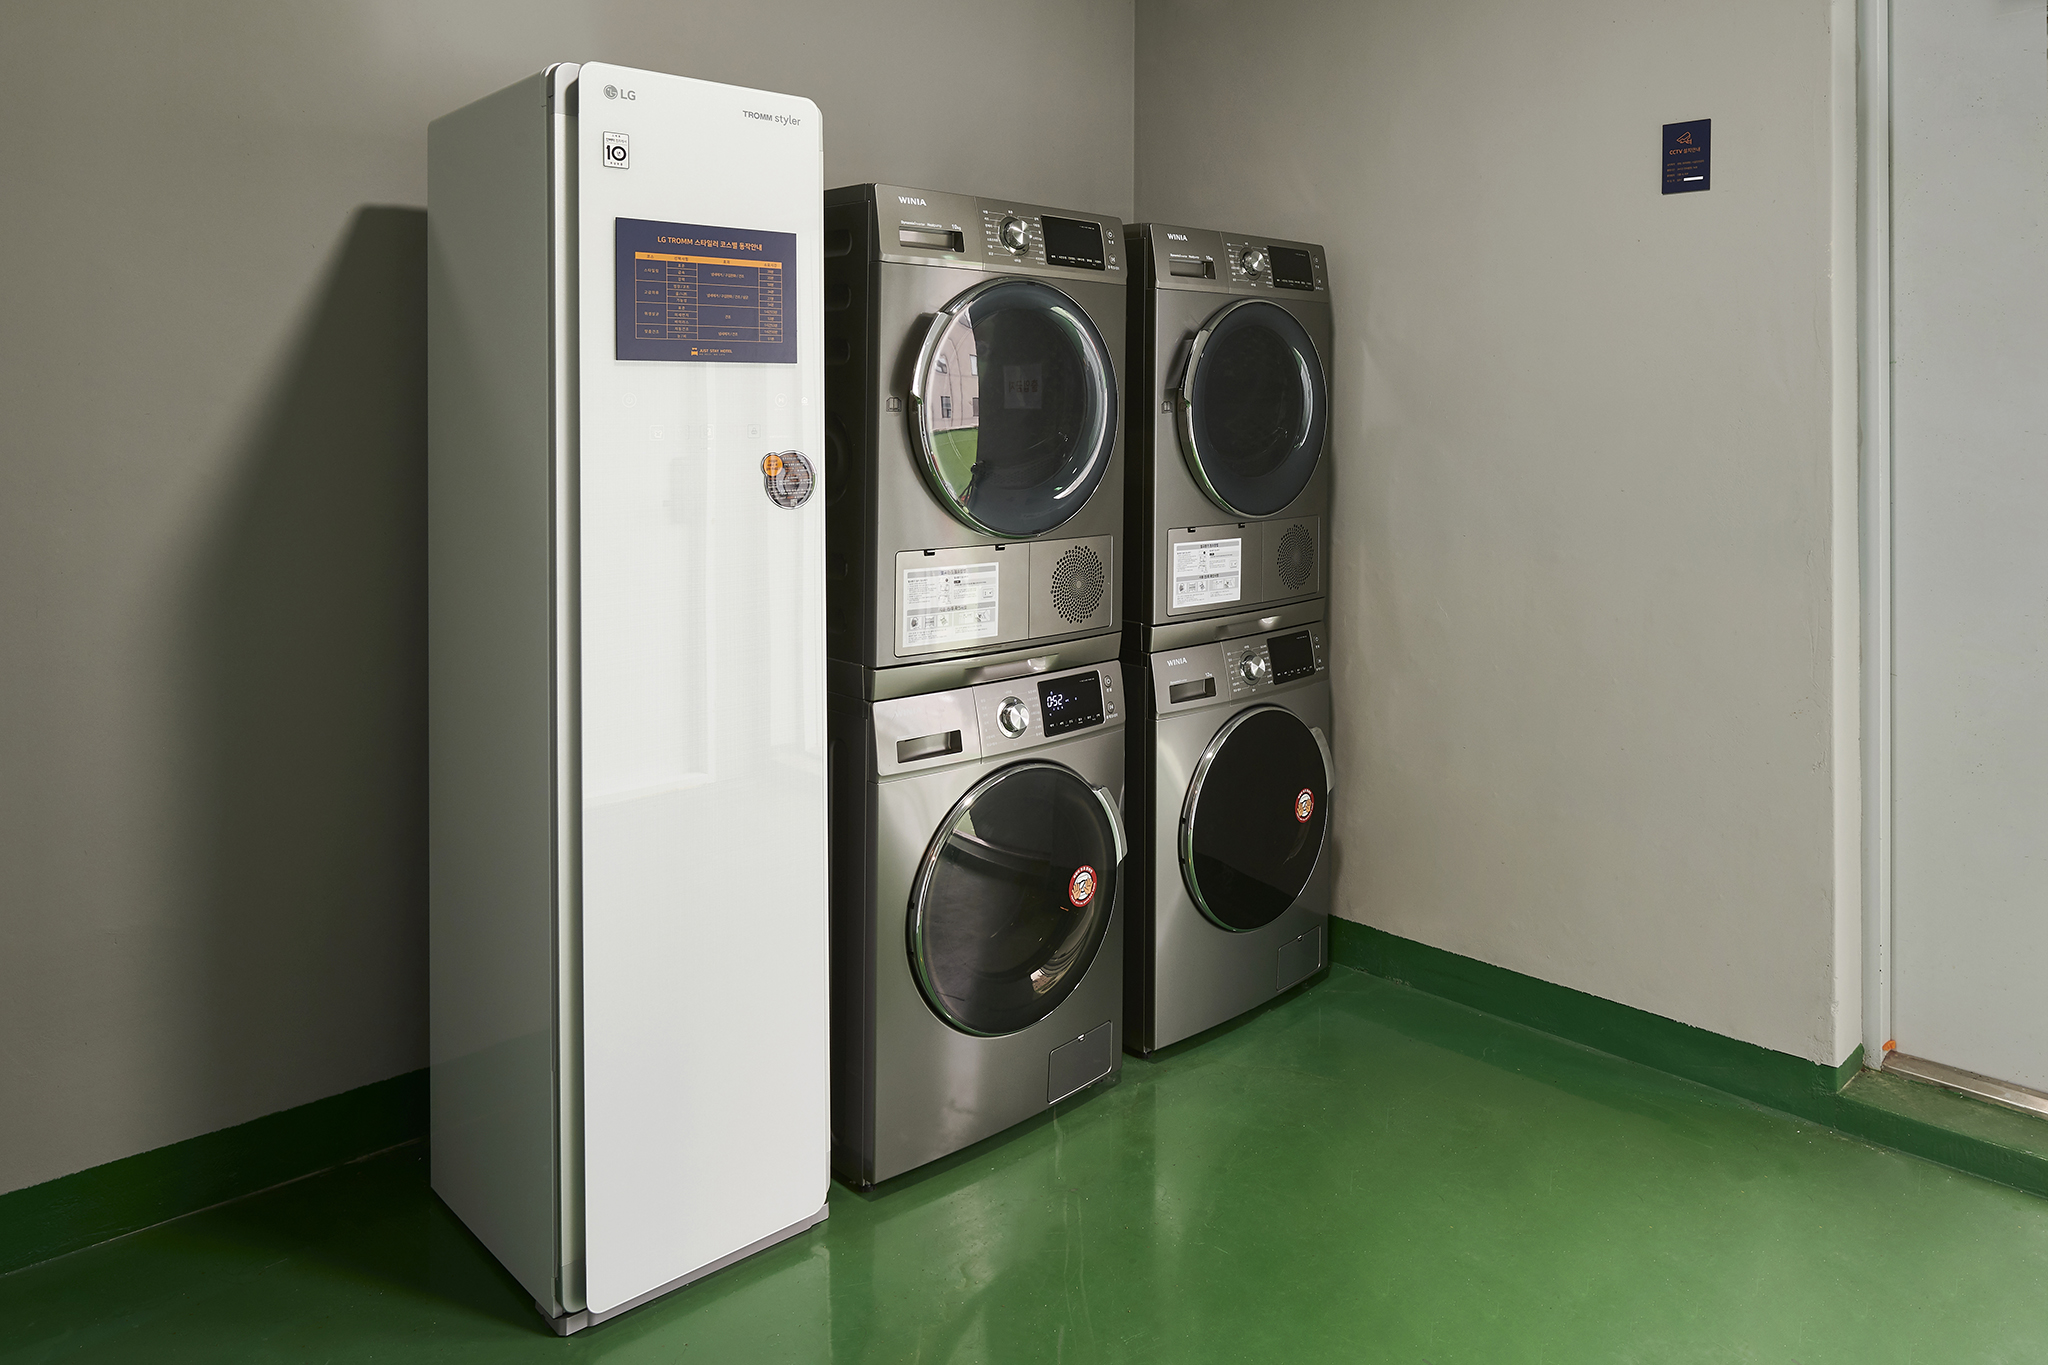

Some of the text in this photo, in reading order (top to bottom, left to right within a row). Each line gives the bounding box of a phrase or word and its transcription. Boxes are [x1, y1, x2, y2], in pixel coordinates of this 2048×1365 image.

[620, 89, 636, 101] LG
[742, 110, 801, 126] TROMM styler
[1669, 148, 1683, 156] CCTV
[898, 196, 927, 206] WINIA
[1166, 233, 1189, 242] WINIA
[657, 235, 762, 251] LG TROMM 스타일러 코스별 동작안내
[1166, 657, 1188, 667] WINIA
